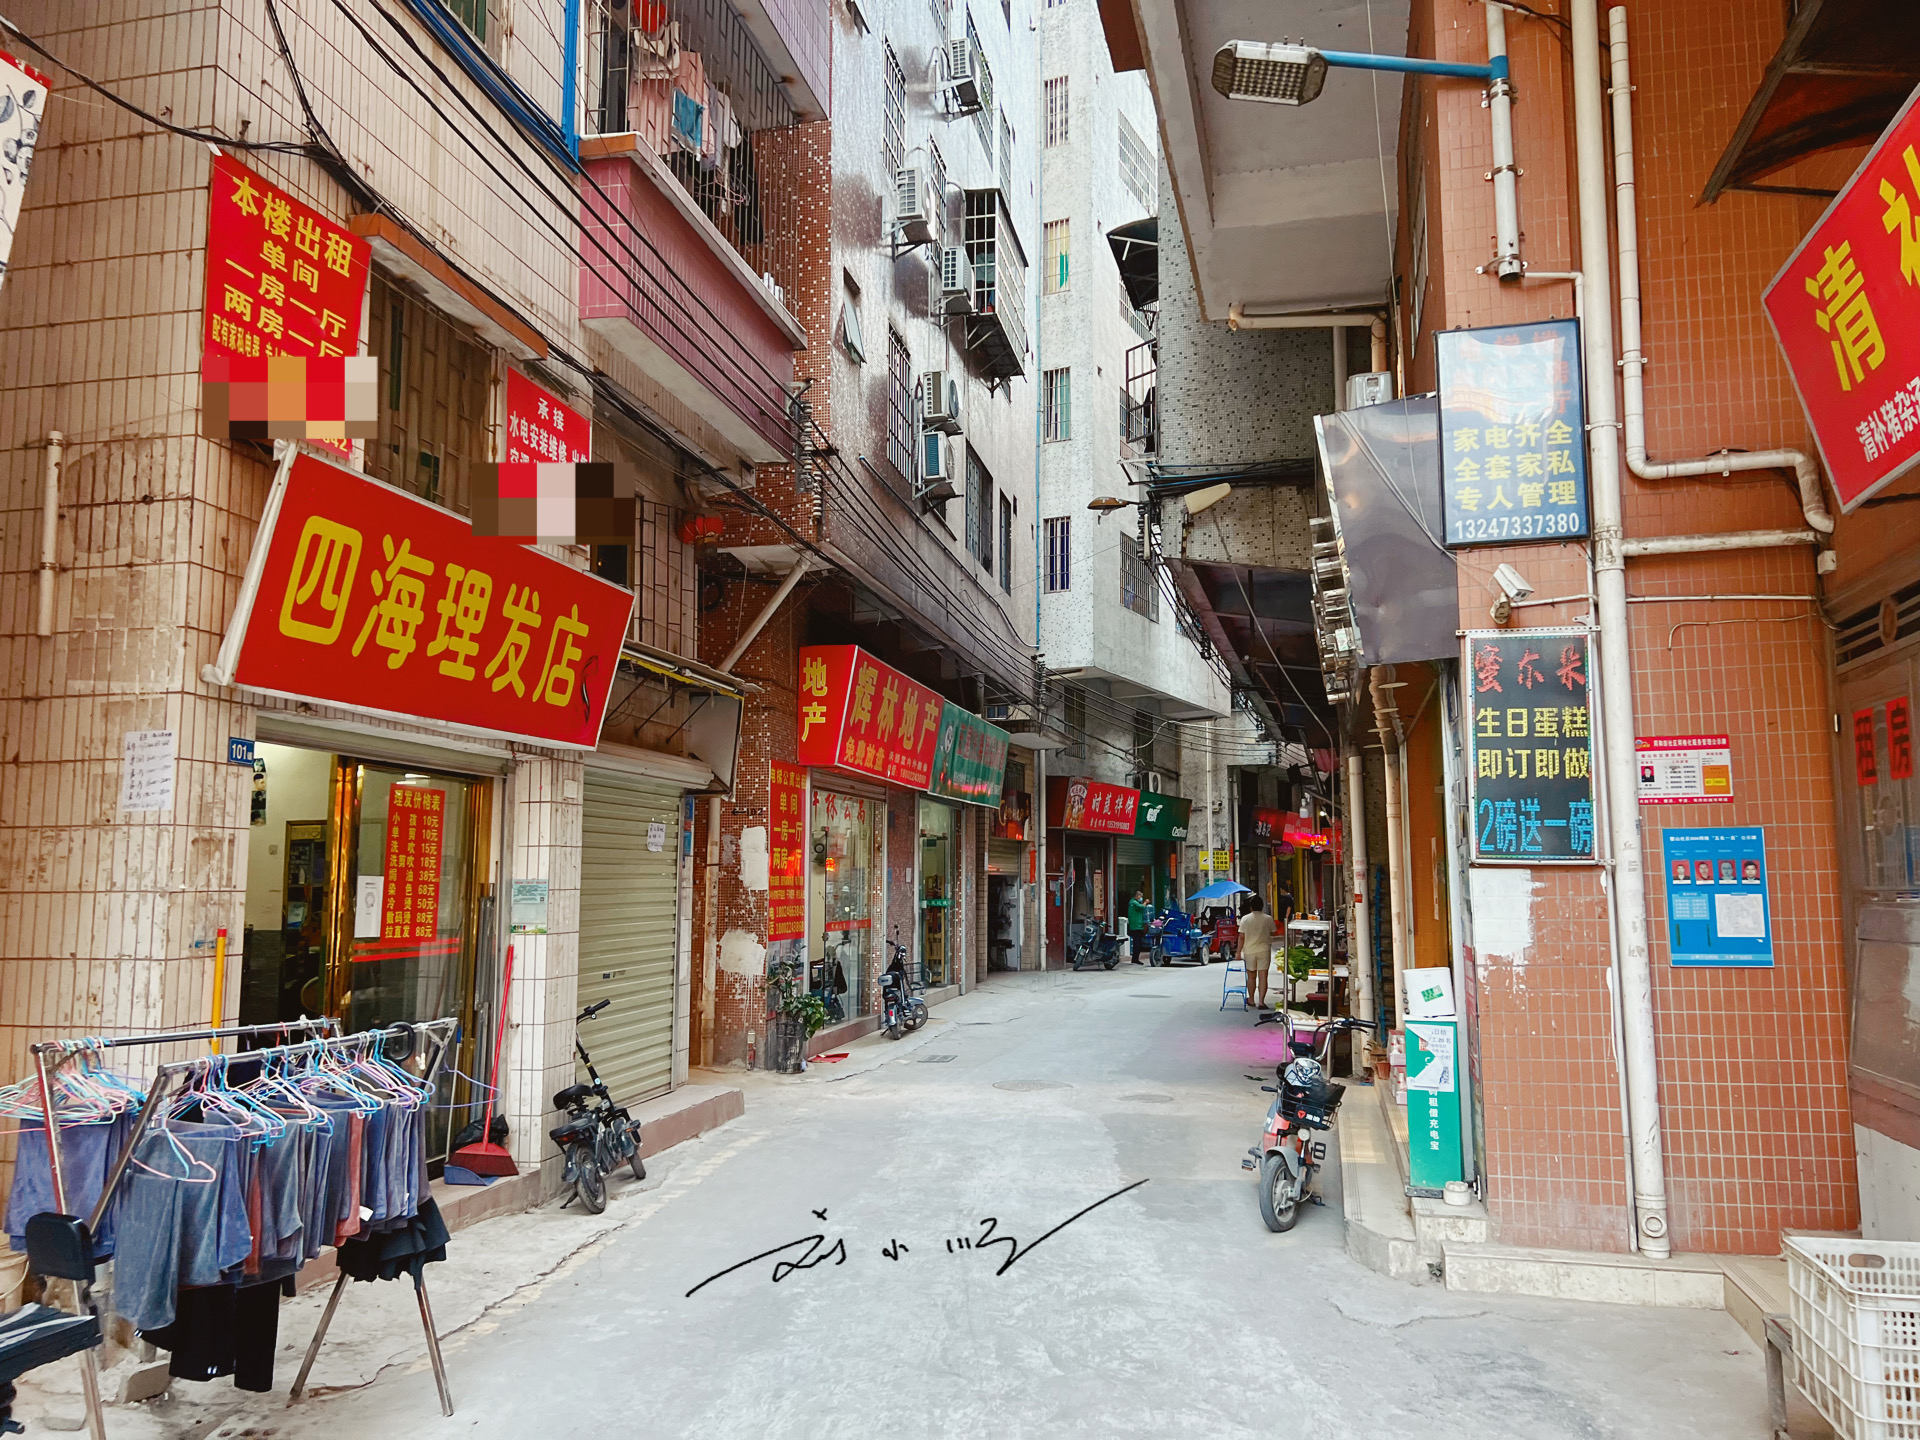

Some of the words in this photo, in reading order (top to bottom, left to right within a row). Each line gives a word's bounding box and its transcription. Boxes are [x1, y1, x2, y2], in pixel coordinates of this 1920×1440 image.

[231, 176, 353, 278] 本楼出租
[260, 240, 319, 293] 单间
[225, 258, 347, 339] 一房一厅
[538, 397, 564, 431] 承接
[509, 410, 567, 463] 水电安装维修
[1453, 420, 1573, 453] 家电齐全
[1453, 449, 1576, 482] 全套家私
[1454, 480, 1578, 512] 专人管理
[1455, 512, 1580, 540] 13247337380
[278, 515, 590, 708] 四海理发店
[801, 657, 828, 743] 地产
[849, 660, 939, 754] 辉林地产
[1476, 706, 1588, 739] 生日蛋糕
[843, 736, 886, 773] 免费放盘
[1478, 747, 1590, 780] 即订即做
[393, 789, 441, 811] 理发价格表
[779, 791, 798, 816] 单间
[391, 826, 416, 840] 单剪
[422, 828, 438, 841] 10元
[392, 812, 417, 827] 小孩
[423, 815, 439, 828] 10元
[773, 821, 803, 844] 一房一厅
[1479, 797, 1592, 853] 2磅送一磅
[389, 854, 415, 868] 洗剪吹
[420, 856, 436, 869] 18元
[390, 842, 416, 854] 洗吹
[421, 842, 437, 855] 15元
[772, 847, 803, 870] 两房一厅
[388, 883, 413, 896] 染色
[418, 884, 435, 896] 68元
[385, 925, 410, 939] 拉直发
[416, 926, 432, 938] 88元
[386, 911, 411, 925] 数码烫
[416, 912, 434, 924] 88元
